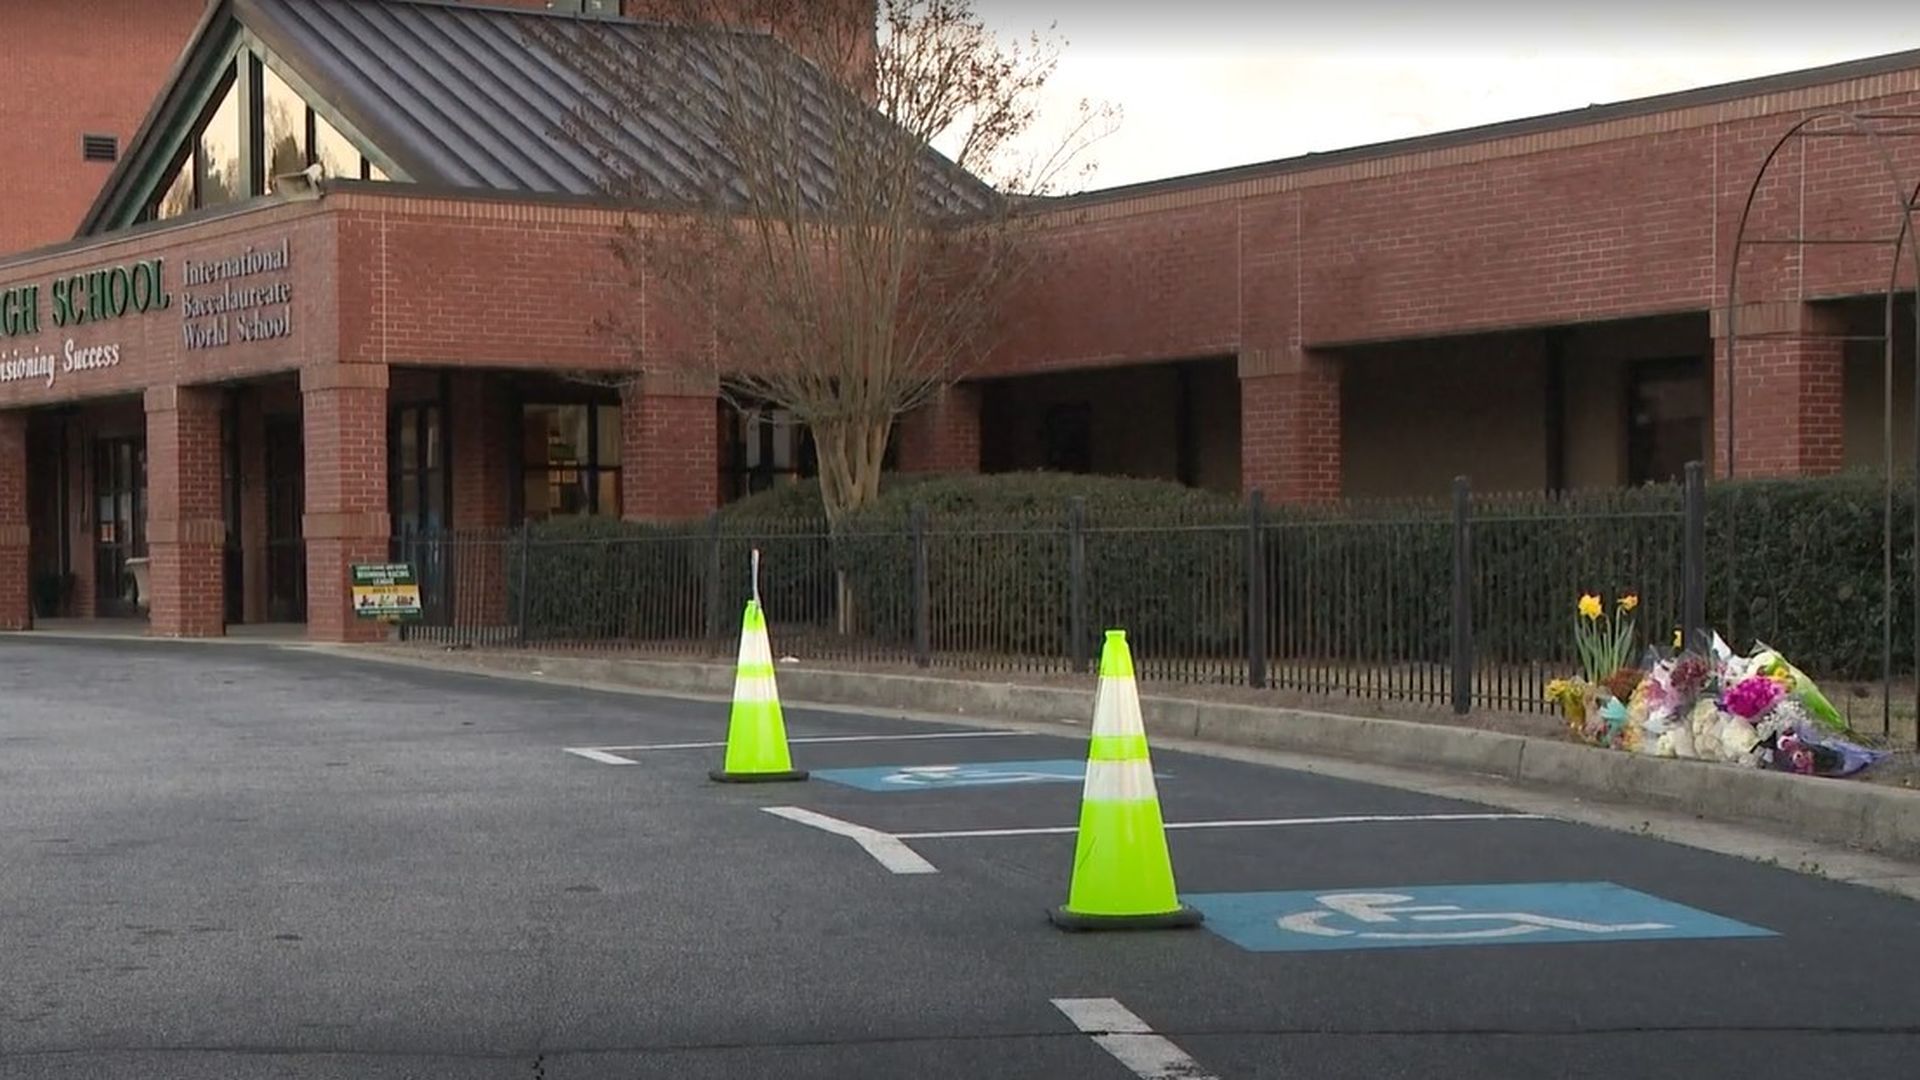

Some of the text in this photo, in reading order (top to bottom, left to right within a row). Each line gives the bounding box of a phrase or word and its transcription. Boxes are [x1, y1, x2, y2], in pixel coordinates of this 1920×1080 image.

[183, 237, 289, 287] International
[0, 256, 172, 337] GH SCHOOL
[182, 281, 291, 318] Baccalaureate
[183, 304, 291, 350] World School
[0, 338, 120, 389] isioning Success
